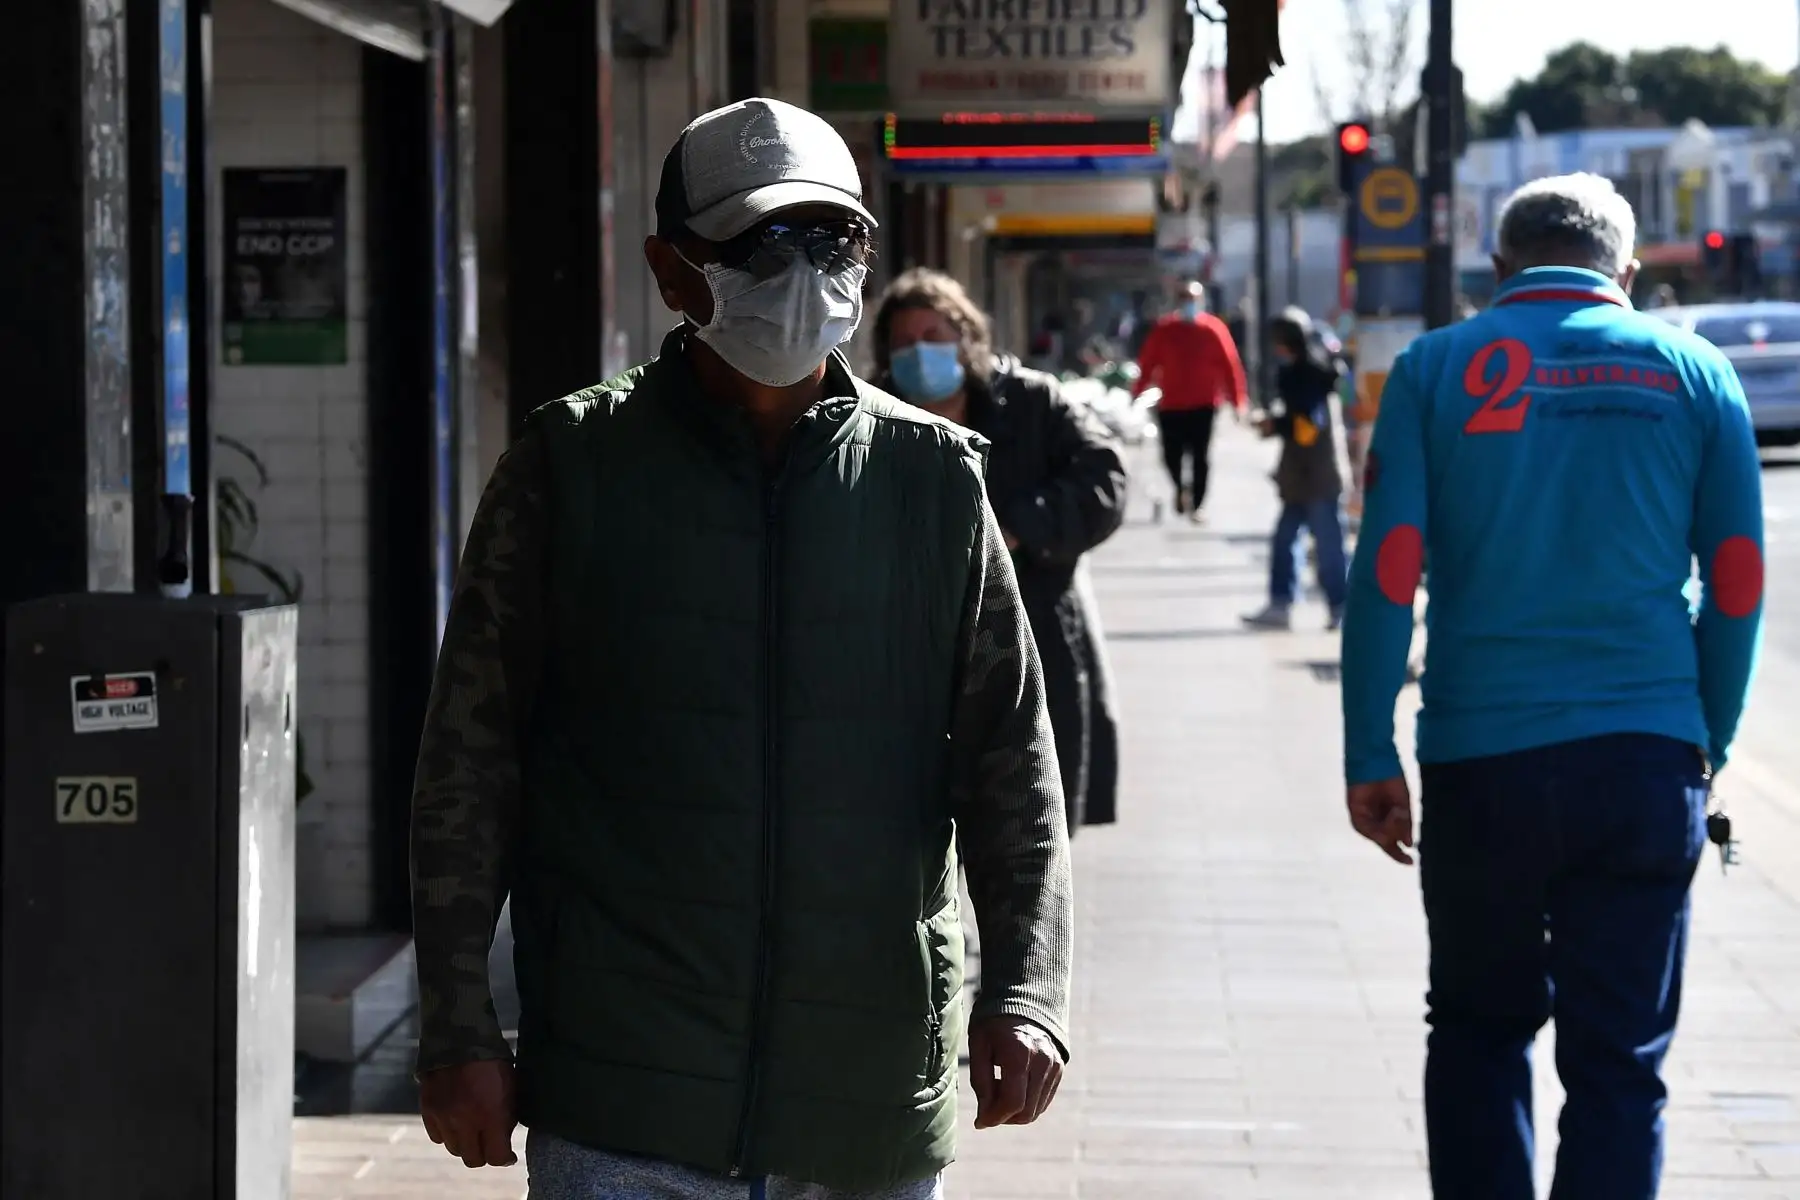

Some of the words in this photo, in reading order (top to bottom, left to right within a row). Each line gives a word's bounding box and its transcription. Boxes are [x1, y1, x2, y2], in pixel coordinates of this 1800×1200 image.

[918, 0, 1146, 21] FAIRFIELD
[932, 26, 1136, 60] TEXTILES
[236, 235, 283, 256] END
[1463, 338, 1532, 434] 2
[1534, 365, 1679, 392] SILVERADO
[108, 702, 150, 718] VOLTAGE
[58, 783, 135, 817] 705
